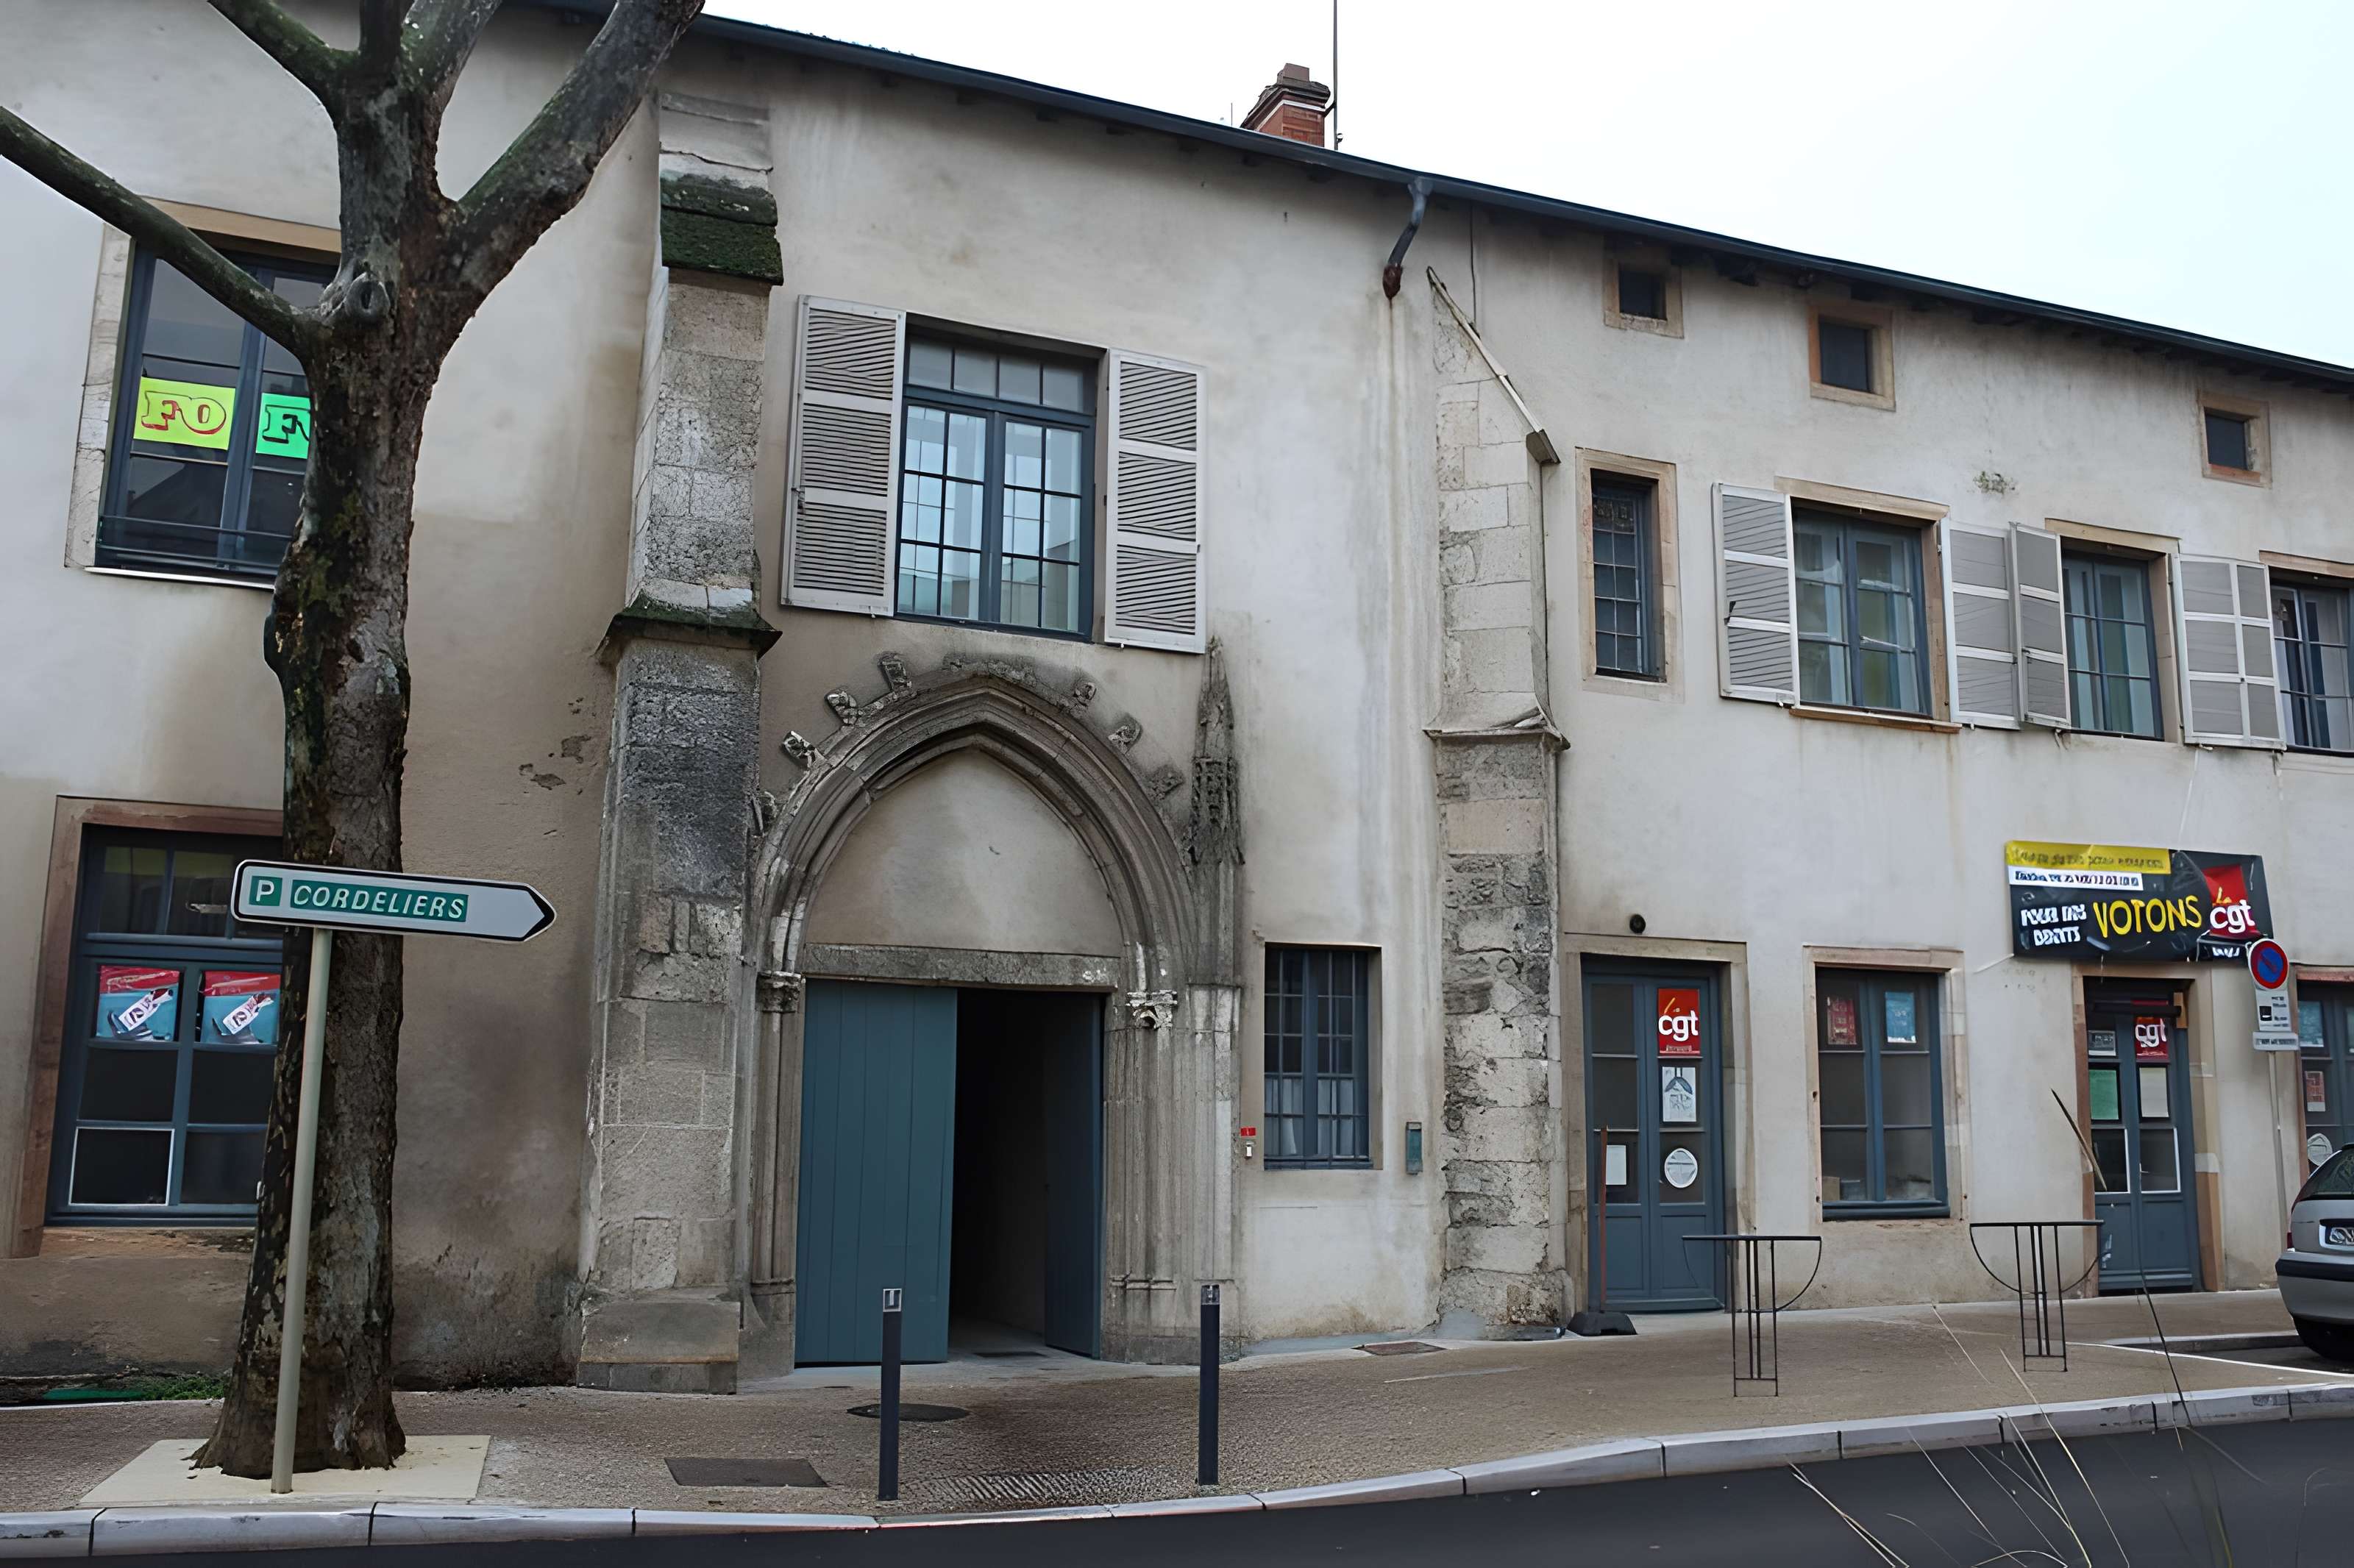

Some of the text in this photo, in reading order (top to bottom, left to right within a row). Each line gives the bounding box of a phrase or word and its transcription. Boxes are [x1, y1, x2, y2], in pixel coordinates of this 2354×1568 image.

[141, 390, 227, 435] FO
[261, 404, 310, 444] F
[255, 880, 466, 920] P CORDELIERS
[2092, 894, 2202, 938] VOTONS
[2209, 899, 2256, 934] cgt
[1657, 1009, 1699, 1042] cgt
[2135, 1018, 2167, 1048] cgt
